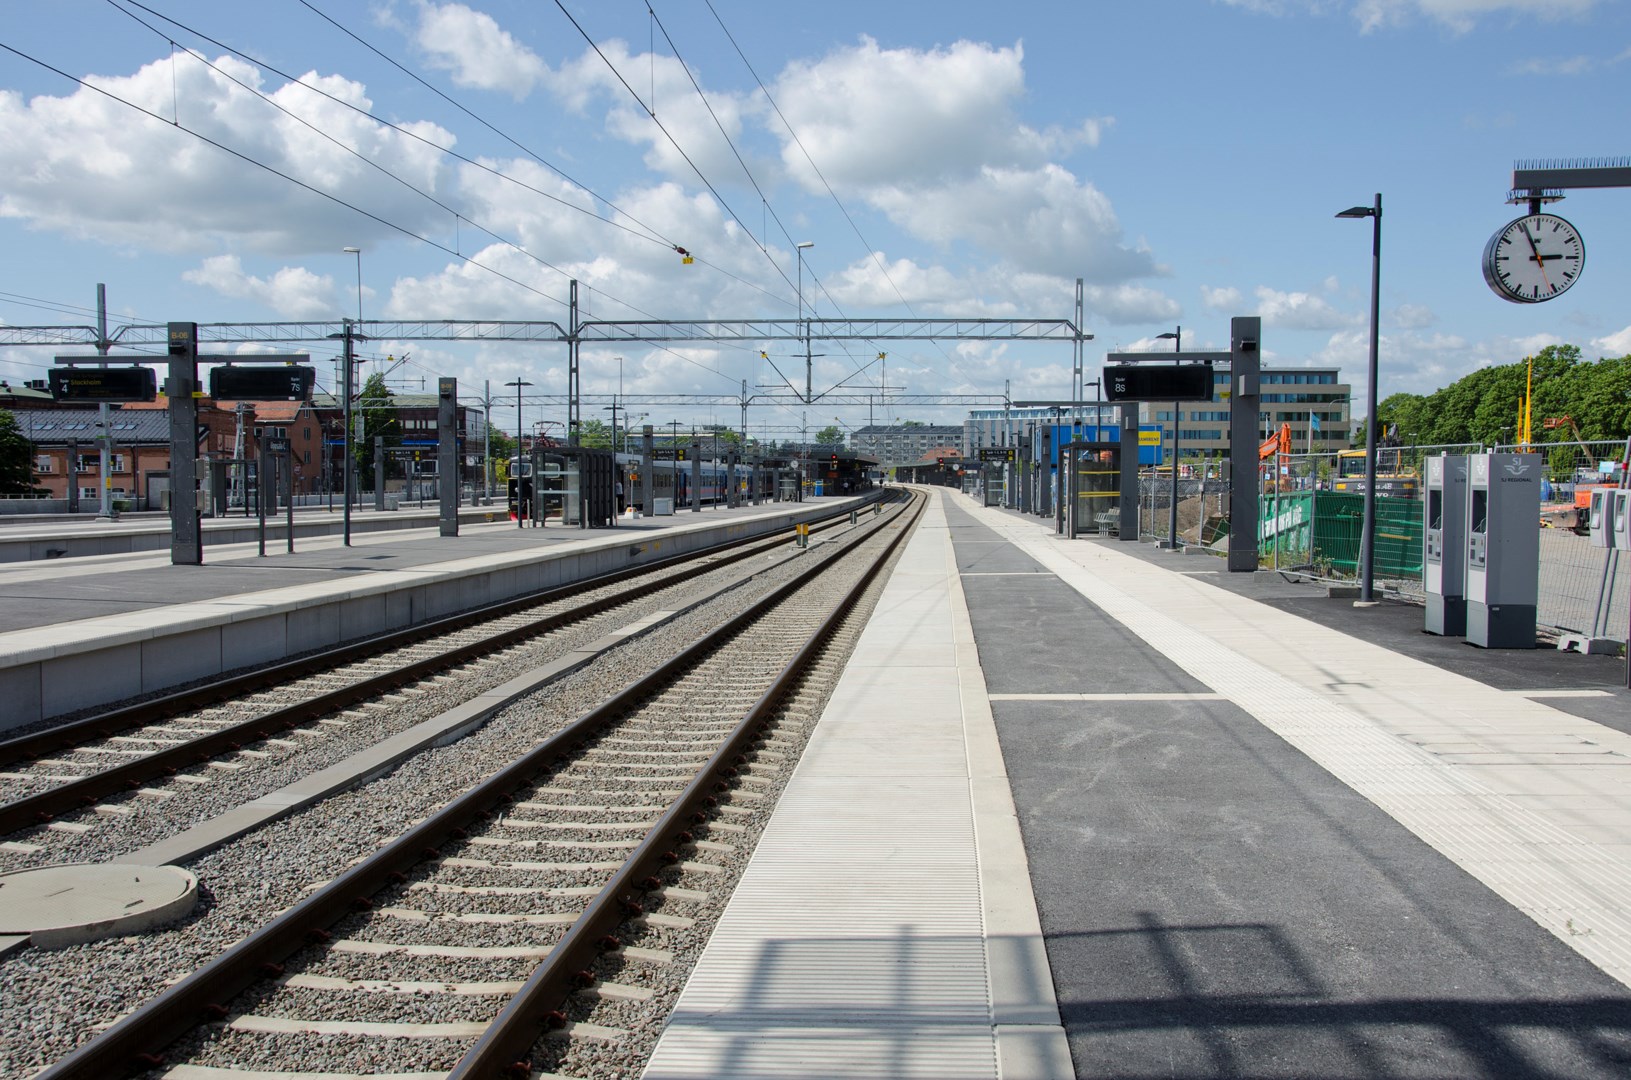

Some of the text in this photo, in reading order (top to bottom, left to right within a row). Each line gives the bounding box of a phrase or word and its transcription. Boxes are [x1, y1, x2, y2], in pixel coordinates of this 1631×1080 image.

[61, 384, 68, 393] 4
[1115, 383, 1126, 392] 8S
[1512, 457, 1522, 467] SJ
